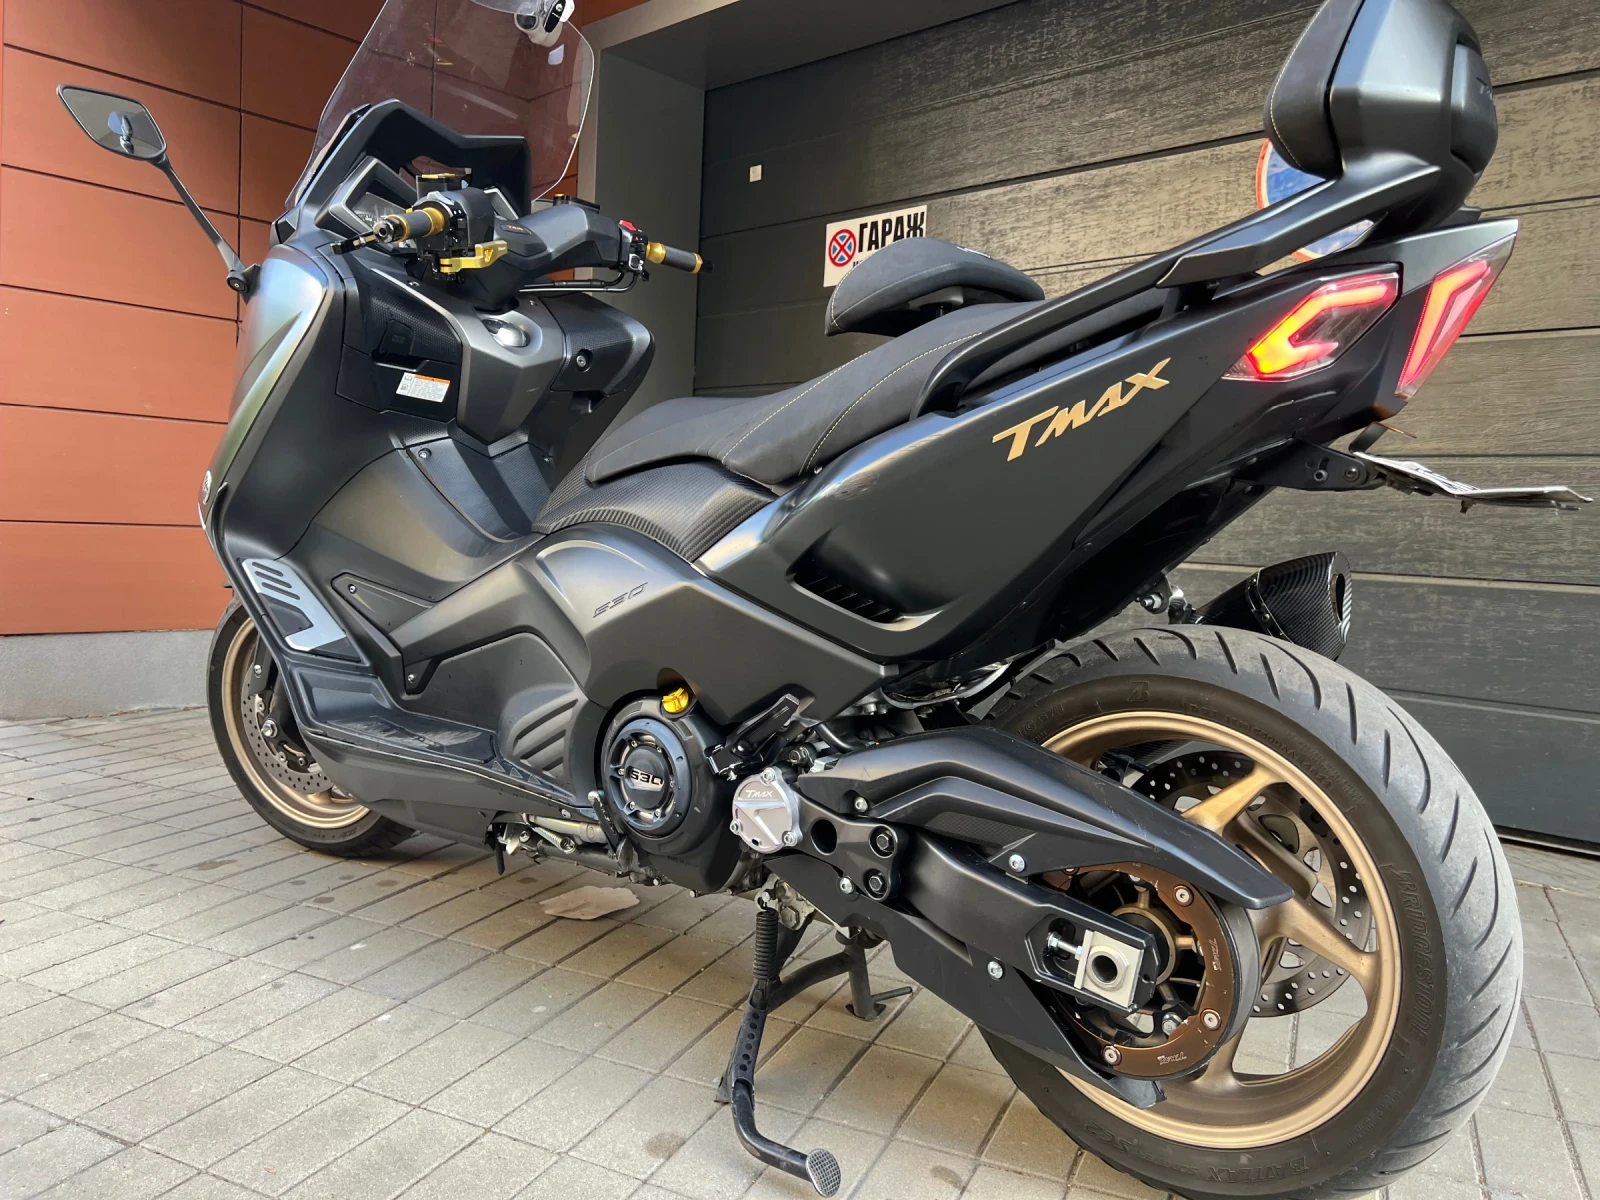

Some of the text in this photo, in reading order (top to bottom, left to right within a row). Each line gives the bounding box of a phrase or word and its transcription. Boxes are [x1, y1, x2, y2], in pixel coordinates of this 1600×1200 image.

[858, 211, 925, 253] ГАРАЖ
[992, 357, 1171, 462] TMAX
[630, 767, 664, 786] 530
[1394, 869, 1435, 1045] BRIDGESTONE
[1208, 1156, 1309, 1183] BATTLAX
